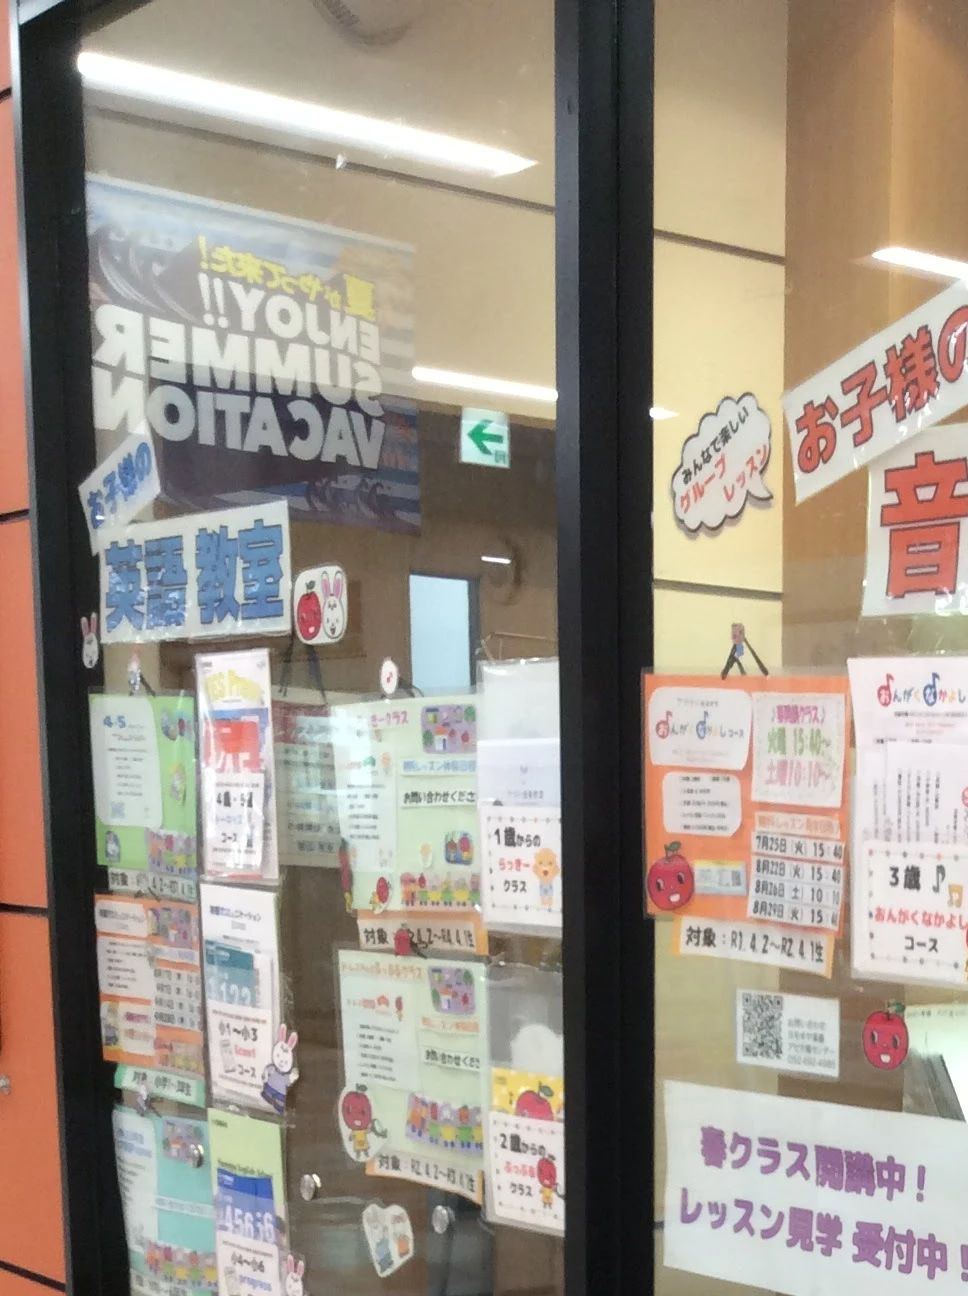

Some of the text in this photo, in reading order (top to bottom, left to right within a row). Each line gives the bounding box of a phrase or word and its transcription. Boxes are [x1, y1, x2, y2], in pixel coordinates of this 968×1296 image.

[682, 406, 749, 485] みんなで楽しい
[723, 444, 769, 502] レッスン
[87, 441, 152, 529] お子様の
[680, 453, 727, 513] グループ
[104, 518, 285, 631] 英語教室
[504, 879, 528, 893] クラス
[889, 866, 921, 891] 3歳
[874, 907, 968, 930] おんがくなかよし
[904, 936, 939, 953] コース
[510, 1182, 533, 1198] クラス
[701, 1126, 926, 1203] 春クラス開講中！
[680, 1187, 843, 1257] レッスン見学
